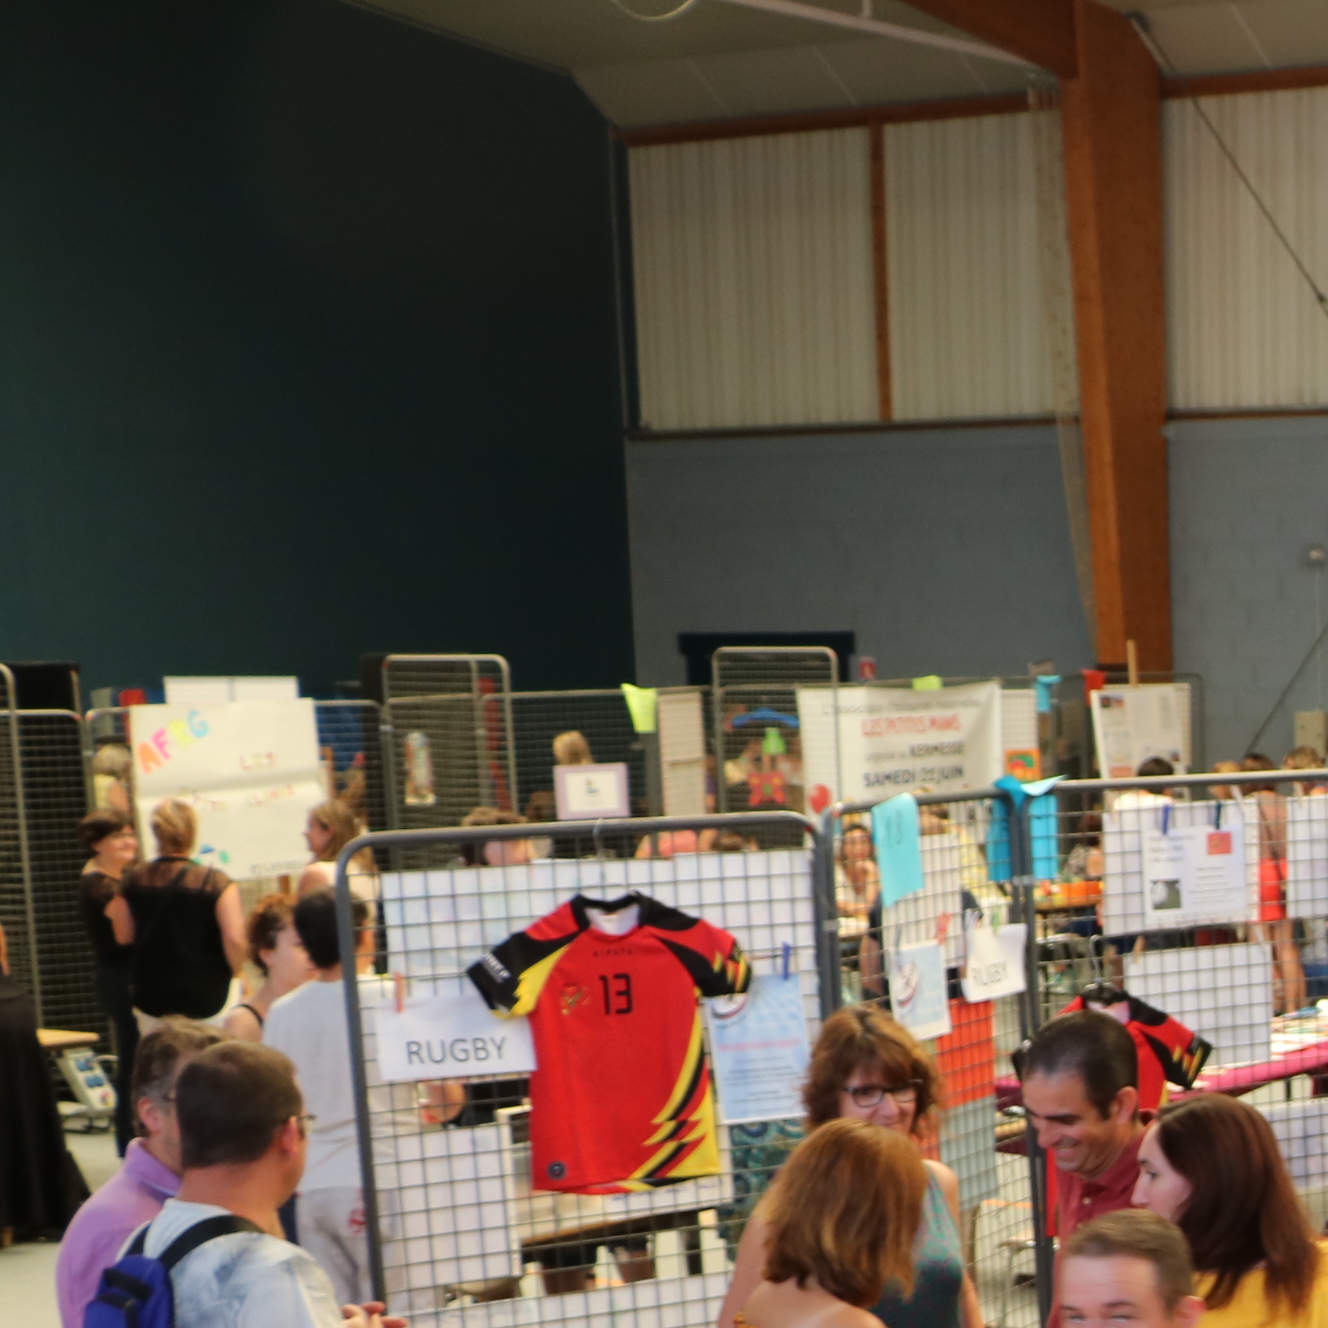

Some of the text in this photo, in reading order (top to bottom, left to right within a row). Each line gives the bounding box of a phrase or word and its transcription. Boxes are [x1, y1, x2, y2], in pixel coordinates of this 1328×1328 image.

[863, 769, 917, 787] SAMEDI
[598, 971, 634, 1016] 13
[406, 1034, 507, 1066] RUGBY
